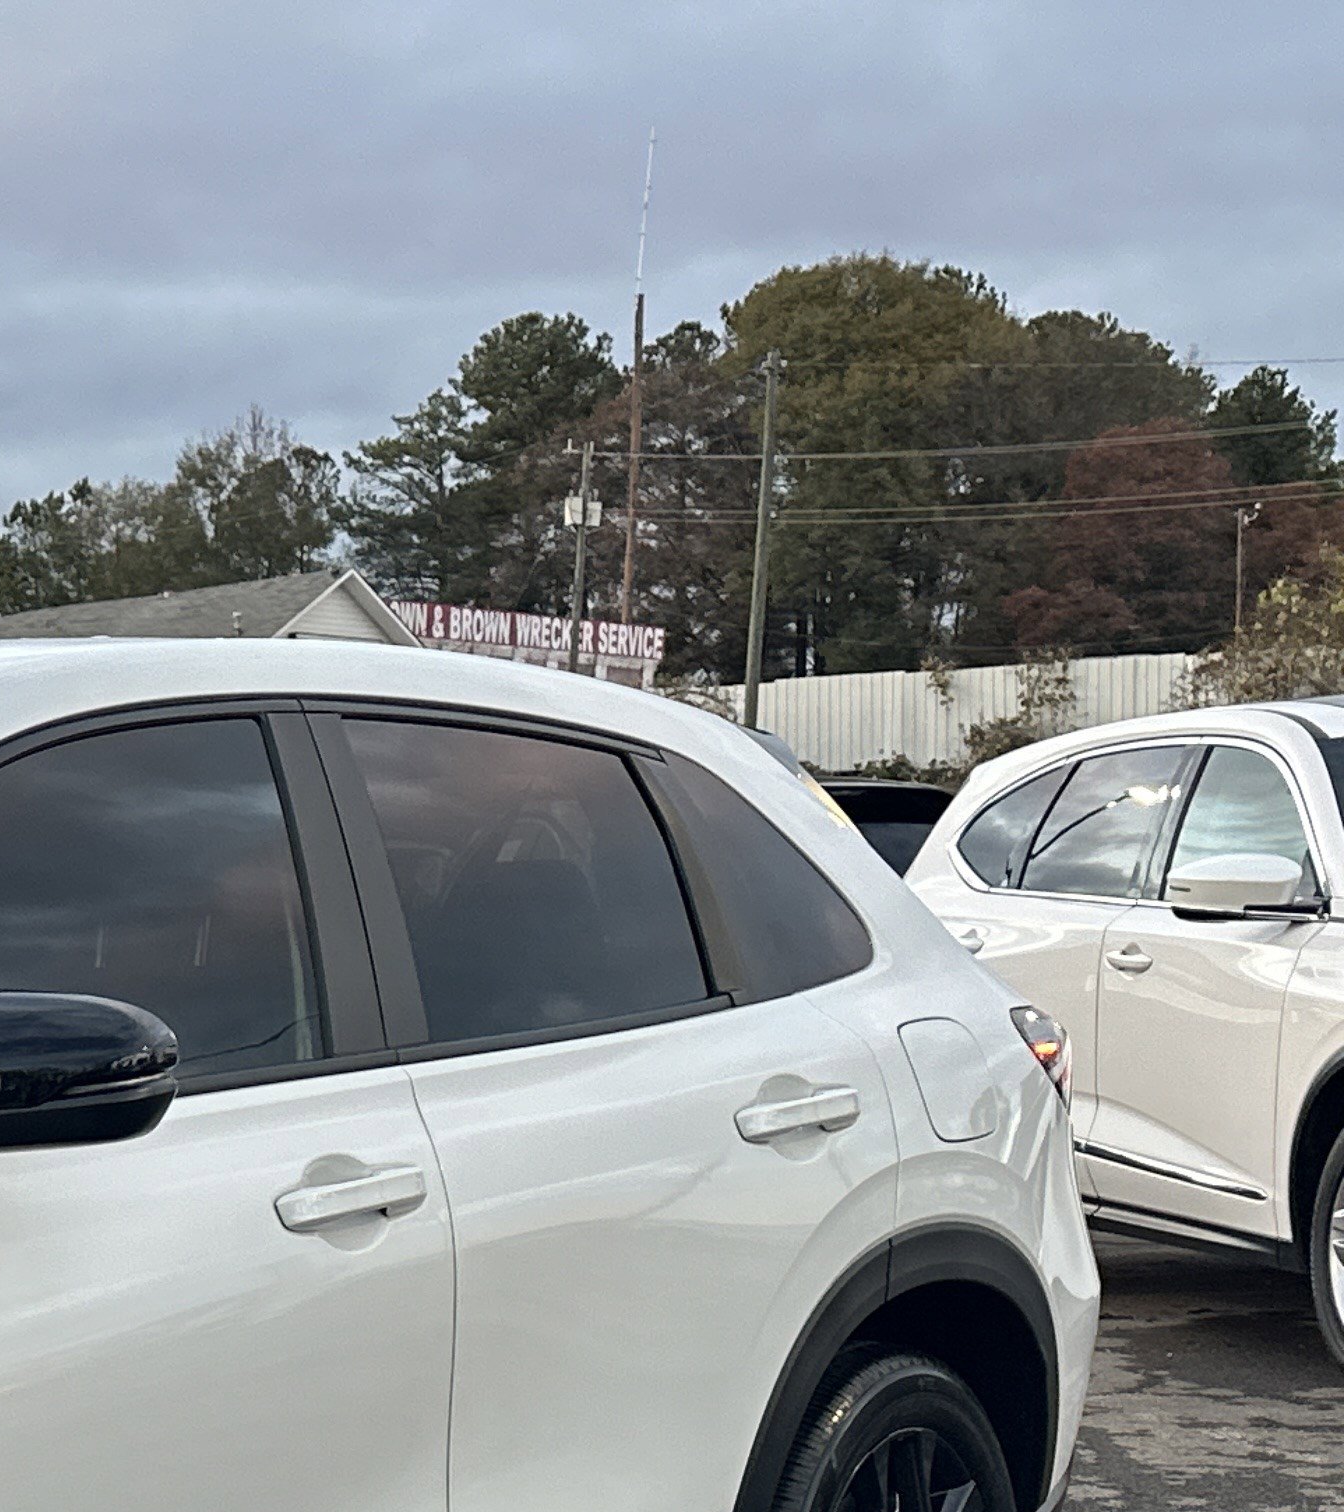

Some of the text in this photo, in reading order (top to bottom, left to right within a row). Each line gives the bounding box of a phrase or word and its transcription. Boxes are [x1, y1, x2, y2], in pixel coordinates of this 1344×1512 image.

[432, 605, 444, 638] &
[450, 606, 511, 645] BROWN
[598, 621, 665, 659] SERVICE
